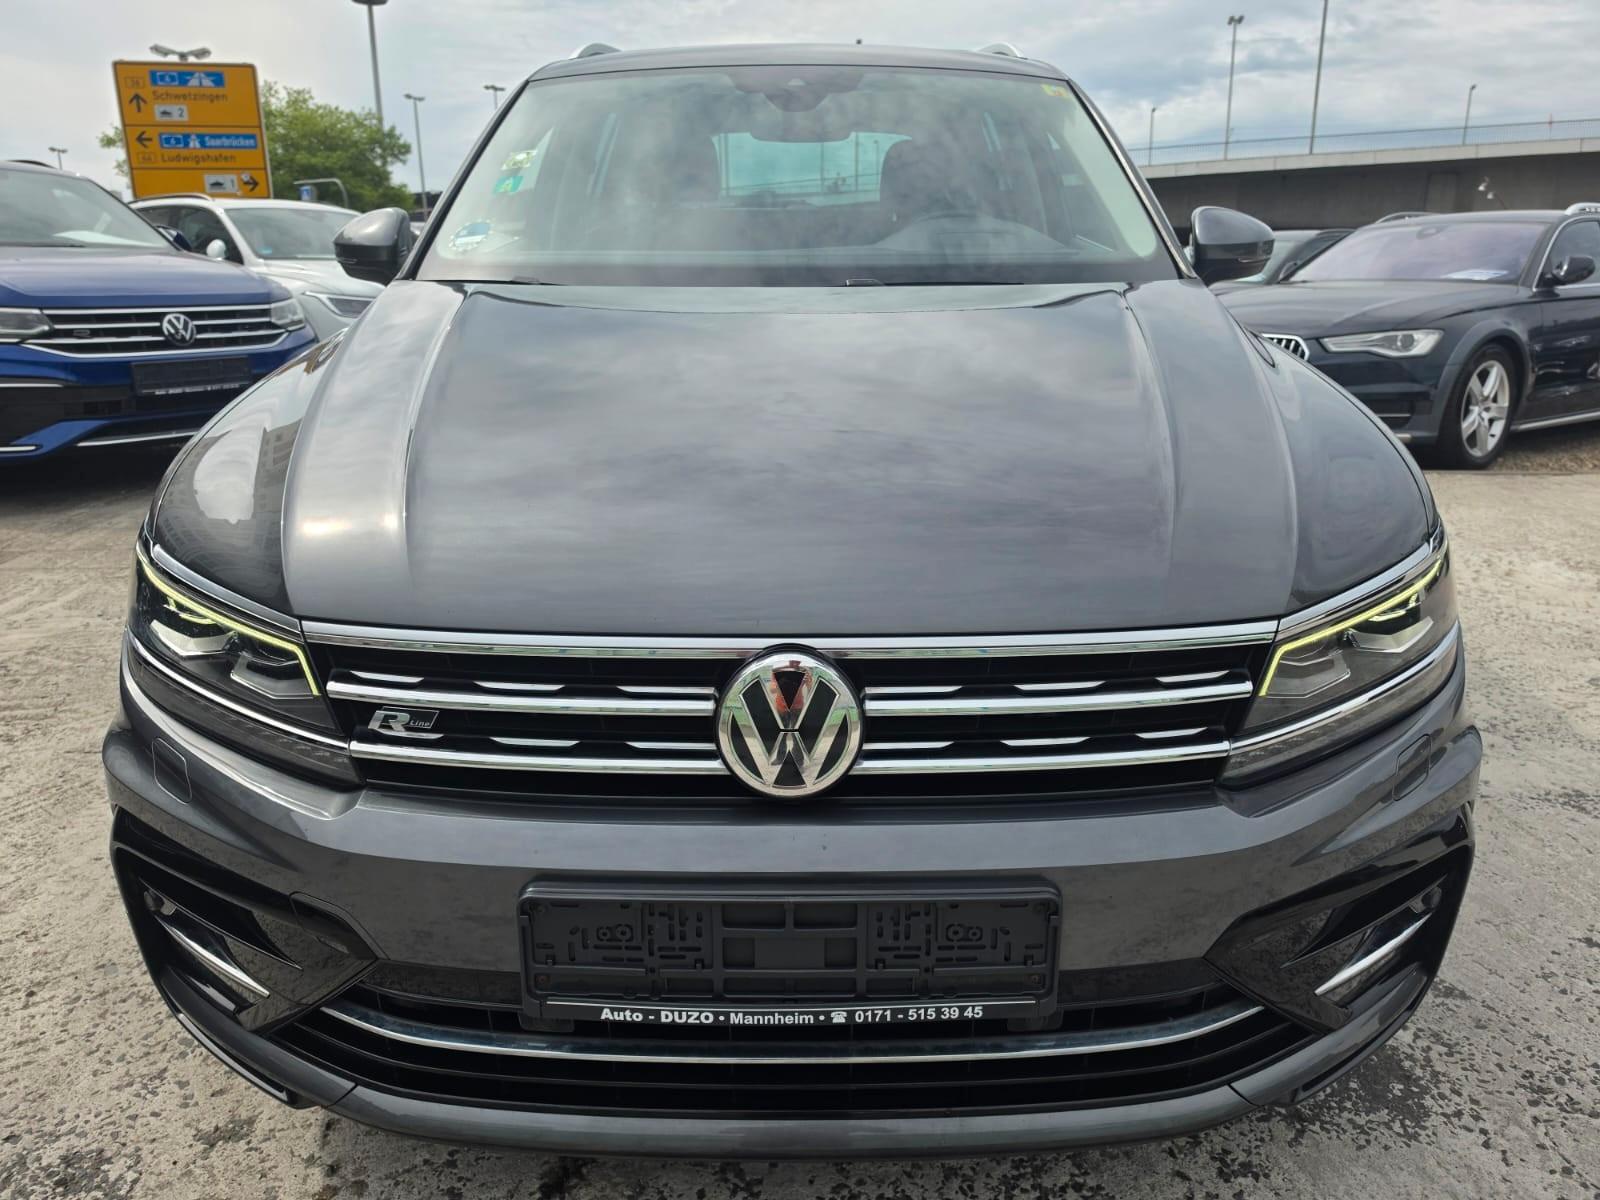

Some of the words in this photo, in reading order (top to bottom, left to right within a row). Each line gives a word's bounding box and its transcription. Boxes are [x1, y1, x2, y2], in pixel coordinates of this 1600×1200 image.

[153, 91, 227, 102] Schwetzingen
[178, 107, 184, 118] 2
[161, 153, 236, 164] Ludwigshafen
[368, 711, 410, 732] R
[722, 656, 861, 795] VW
[600, 1008, 643, 1022] Auto
[660, 1010, 714, 1023] DUZO
[730, 1012, 814, 1025] Mannheim
[855, 1010, 892, 1023] 0171
[908, 1008, 936, 1020] 515
[941, 1007, 959, 1019] 39
[964, 1006, 983, 1018] 45
